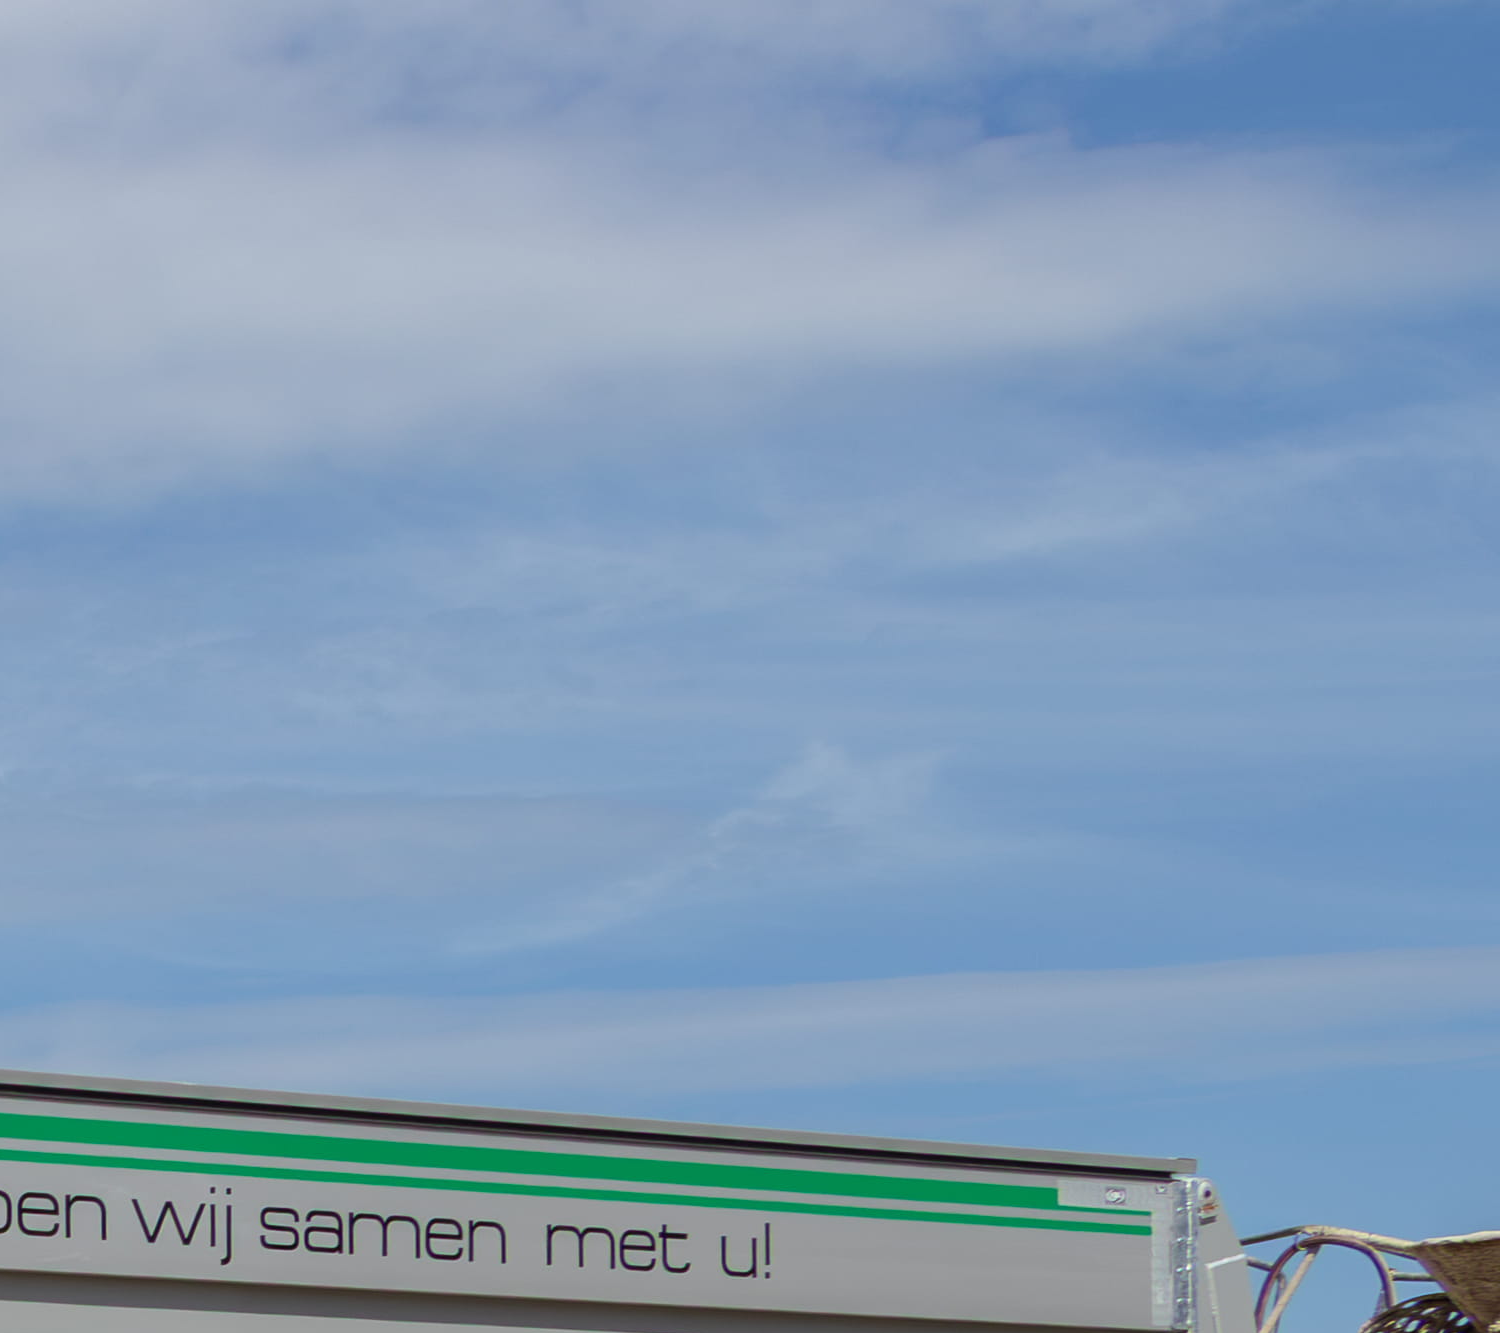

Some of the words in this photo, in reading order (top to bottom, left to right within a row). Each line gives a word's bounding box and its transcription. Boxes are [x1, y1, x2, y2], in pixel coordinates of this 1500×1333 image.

[131, 1186, 233, 1266] wij
[258, 1204, 508, 1265] samen
[545, 1221, 692, 1275] met
[720, 1221, 772, 1280] u!
